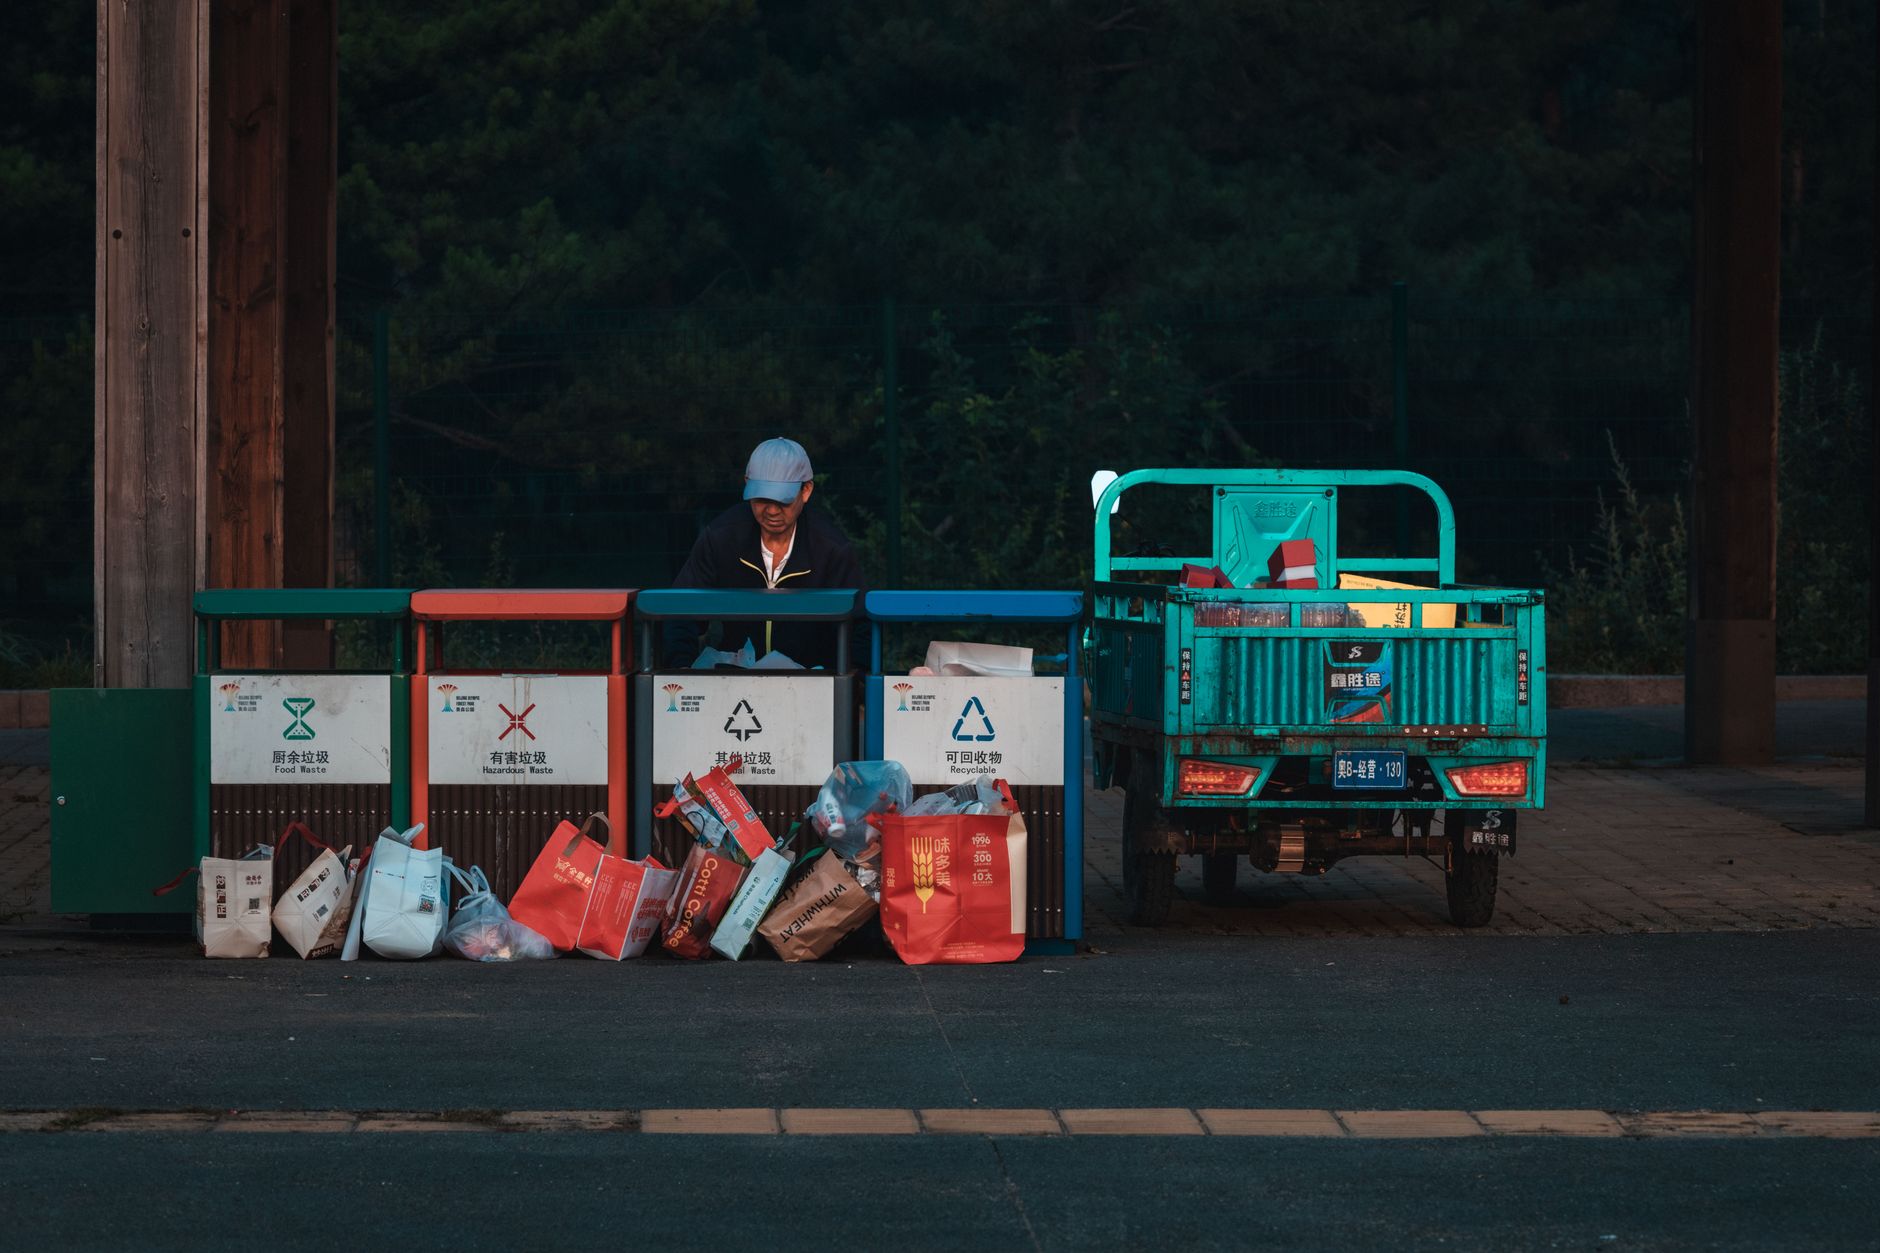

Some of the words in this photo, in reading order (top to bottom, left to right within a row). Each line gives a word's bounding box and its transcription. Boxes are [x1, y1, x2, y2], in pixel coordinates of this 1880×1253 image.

[1330, 672, 1381, 687] 鑫胜途
[272, 750, 330, 765] 厨余垃圾
[490, 750, 547, 766] 有害垃圾
[945, 751, 1002, 765] 可回收物
[274, 765, 296, 774] Food
[300, 765, 327, 774] Waste
[482, 765, 525, 774] Hazardous
[529, 765, 554, 774] Waste
[751, 767, 776, 775] Waste
[950, 765, 997, 775] Recyclable
[972, 836, 991, 845] 1996
[933, 837, 952, 888] 味多美
[973, 854, 992, 863] 300
[694, 857, 718, 897] Cotti
[971, 872, 993, 881] 10大
[782, 882, 848, 943] WITHWHEAT
[669, 899, 701, 948] Coffee
